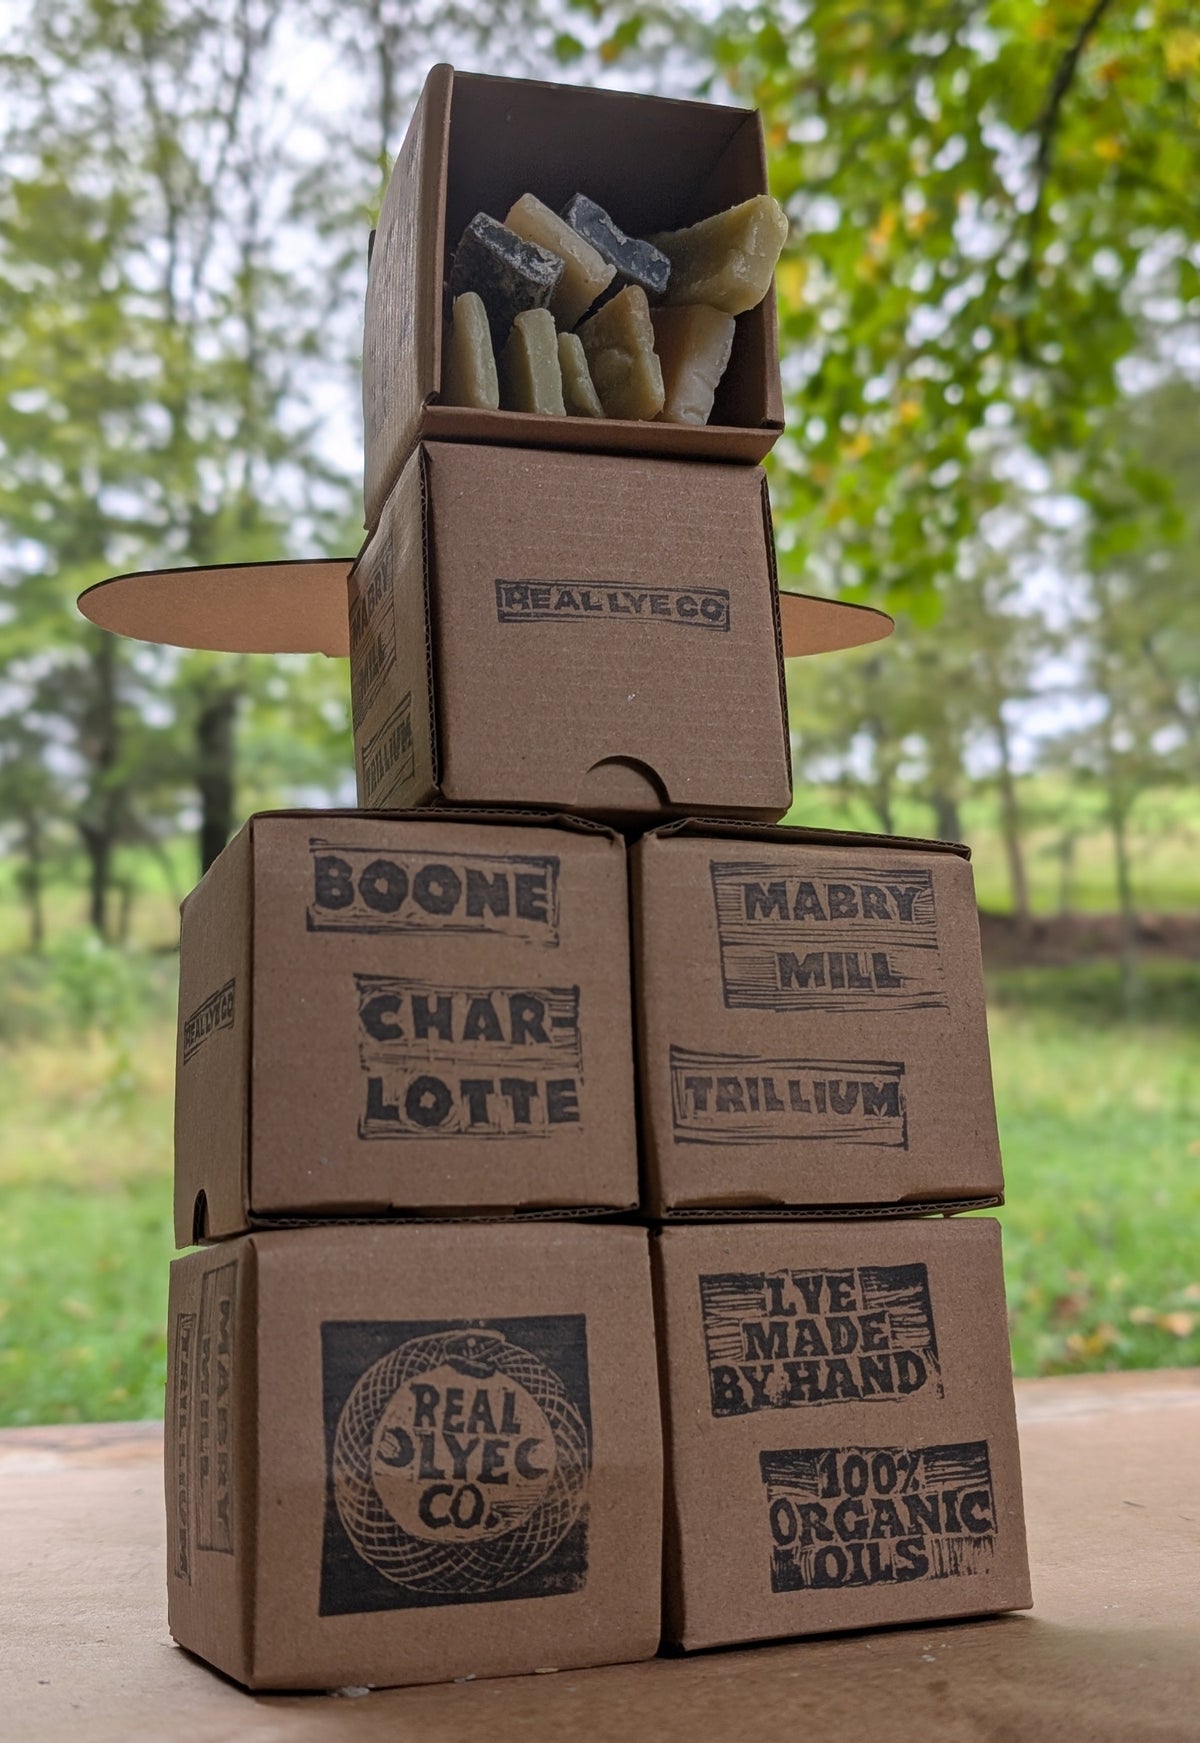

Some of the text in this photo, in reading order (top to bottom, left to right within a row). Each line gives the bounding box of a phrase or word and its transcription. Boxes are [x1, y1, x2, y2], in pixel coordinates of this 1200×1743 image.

[314, 856, 549, 923] BOONE
[743, 880, 920, 922] MABRY
[776, 951, 902, 990] MILL
[364, 1074, 580, 1128] LOTTE
[685, 1076, 901, 1118] TRILLIUM
[765, 1276, 857, 1317] LYE
[742, 1311, 889, 1361] MADE
[711, 1350, 928, 1407] BY HAND
[410, 1382, 521, 1435] REAL
[818, 1450, 924, 1500] 100%
[769, 1489, 995, 1546] ORGANIC
[813, 1537, 929, 1584] OILS
